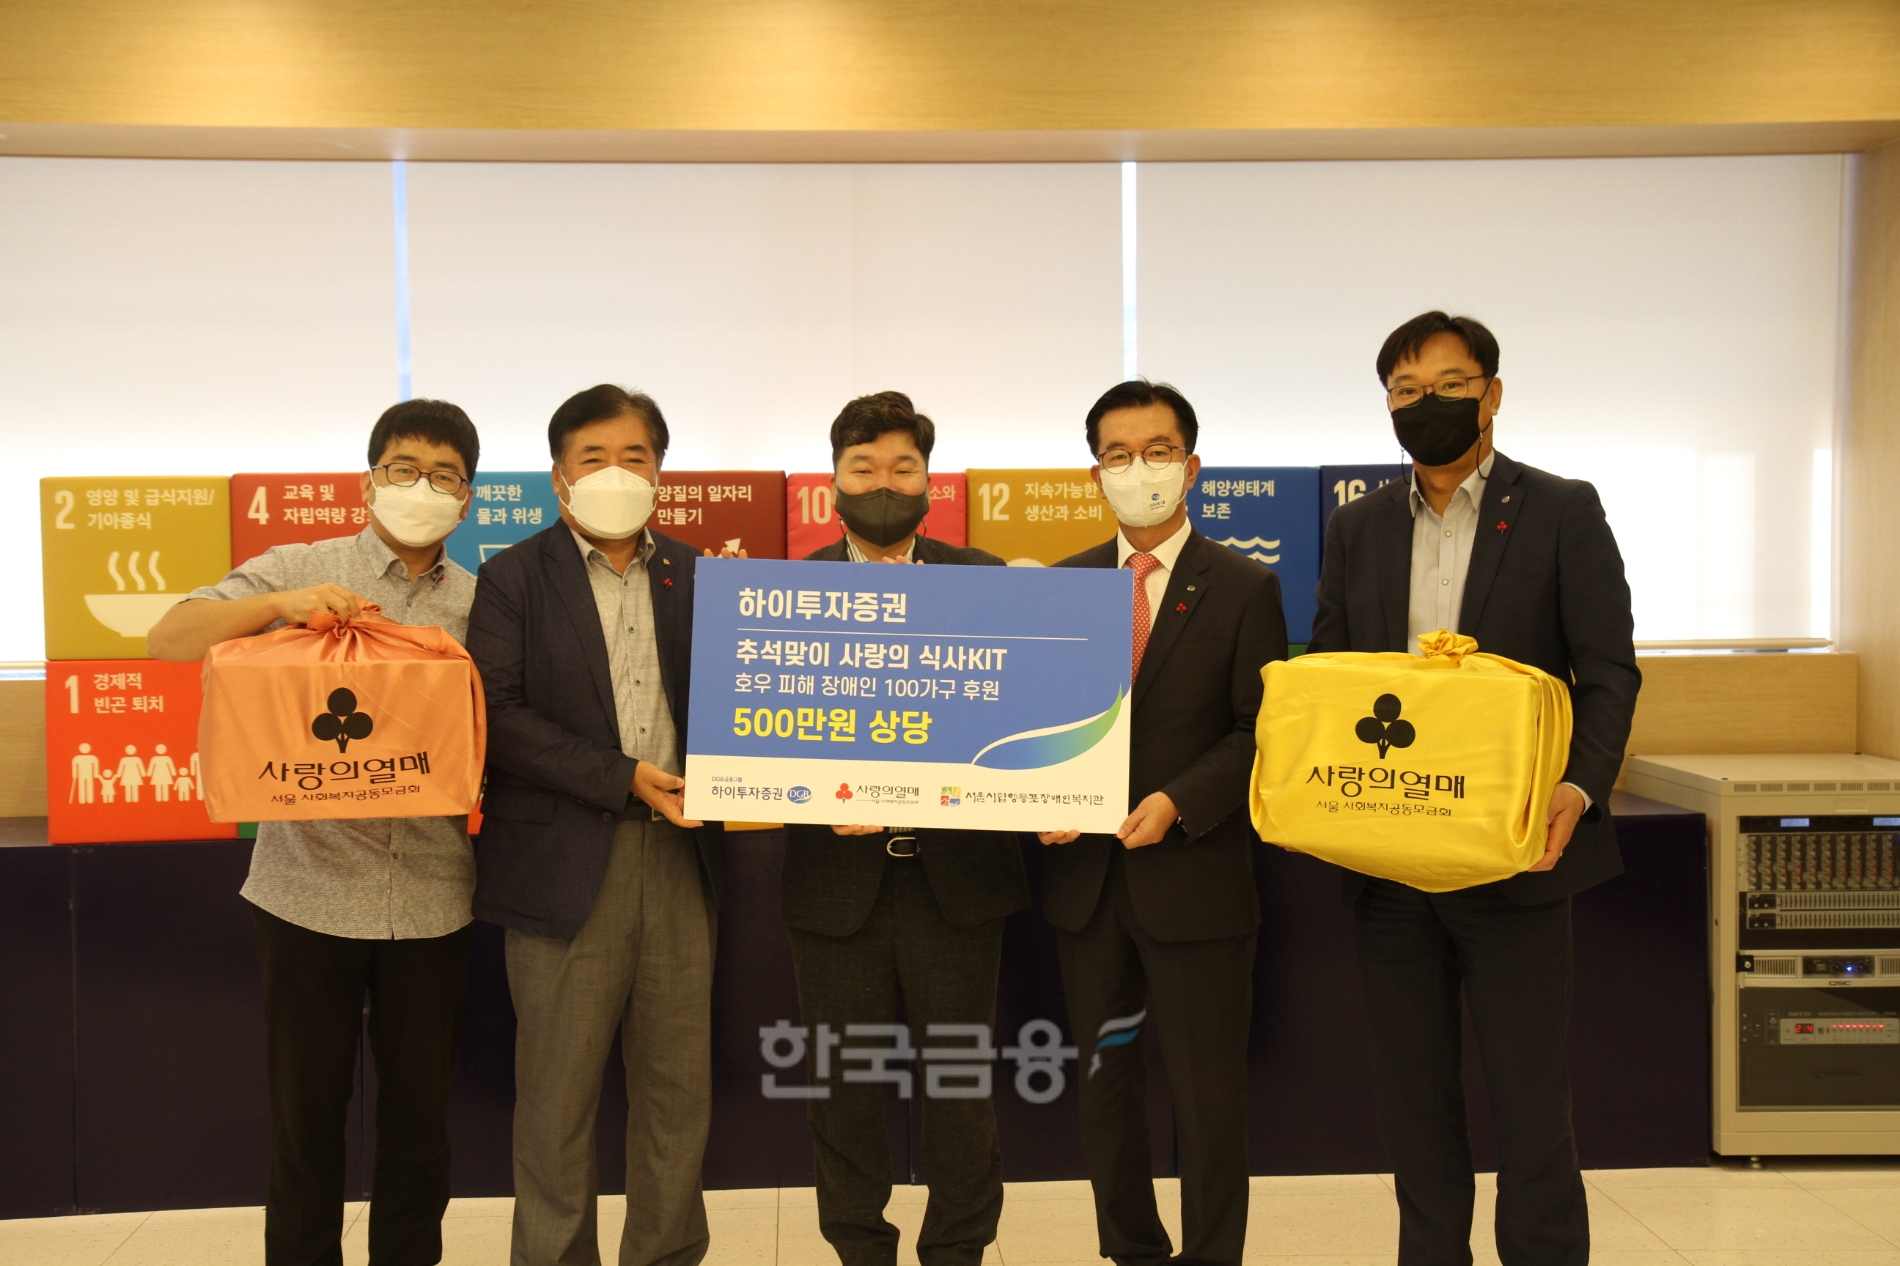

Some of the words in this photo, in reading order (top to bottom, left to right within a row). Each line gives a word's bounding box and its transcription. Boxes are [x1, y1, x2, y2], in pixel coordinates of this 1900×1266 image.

[86, 489, 119, 506] 영양
[124, 489, 140, 506] 및
[144, 488, 215, 506] 급식지원/
[283, 484, 315, 501] 교육
[319, 484, 335, 501] 및
[476, 484, 523, 502] 깨끗한
[658, 485, 702, 502] 양질의
[707, 485, 752, 502] 일자리
[1025, 482, 1098, 499] 지속가능한
[1201, 480, 1275, 497] 해양생태계
[1334, 479, 1366, 506] 16
[54, 490, 75, 530] 2
[247, 486, 270, 525] 4
[797, 486, 832, 525] 10
[978, 483, 1010, 521] 12
[1201, 503, 1231, 519] 보존
[87, 512, 152, 530] 기아종식
[283, 507, 347, 525] 자립역량
[351, 507, 371, 525] 강
[476, 507, 508, 525] 물과
[512, 507, 542, 525] 위생
[657, 508, 702, 525] 만들기
[1025, 504, 1069, 522] 생산과
[1073, 504, 1103, 521] 소비
[738, 587, 907, 623] 하이투자증권
[736, 639, 830, 668] 추석맞이
[839, 642, 909, 670] 사랑의
[919, 645, 1007, 672] 식사KIT
[93, 672, 143, 690] 경제적
[734, 673, 772, 695] 호우
[778, 675, 815, 696] 피해
[822, 676, 877, 698] 장애인
[885, 678, 956, 700] 100가구
[962, 680, 1000, 701] 후원
[64, 675, 79, 714] 1
[94, 696, 127, 714] 빈곤
[131, 695, 164, 713] 퇴치
[733, 707, 857, 743] 500만원
[869, 710, 933, 745] 상당
[258, 751, 431, 791] 사랑의열매
[856, 785, 919, 799] 사랑의열매
[1305, 765, 1465, 801] 사랑의열매
[270, 793, 297, 805] 서울
[301, 785, 420, 801] 사회복지공동모금회
[711, 785, 783, 801] 하이투자증권
[1316, 800, 1339, 813] 서울
[1343, 801, 1452, 817] 사회복지공동모금회
